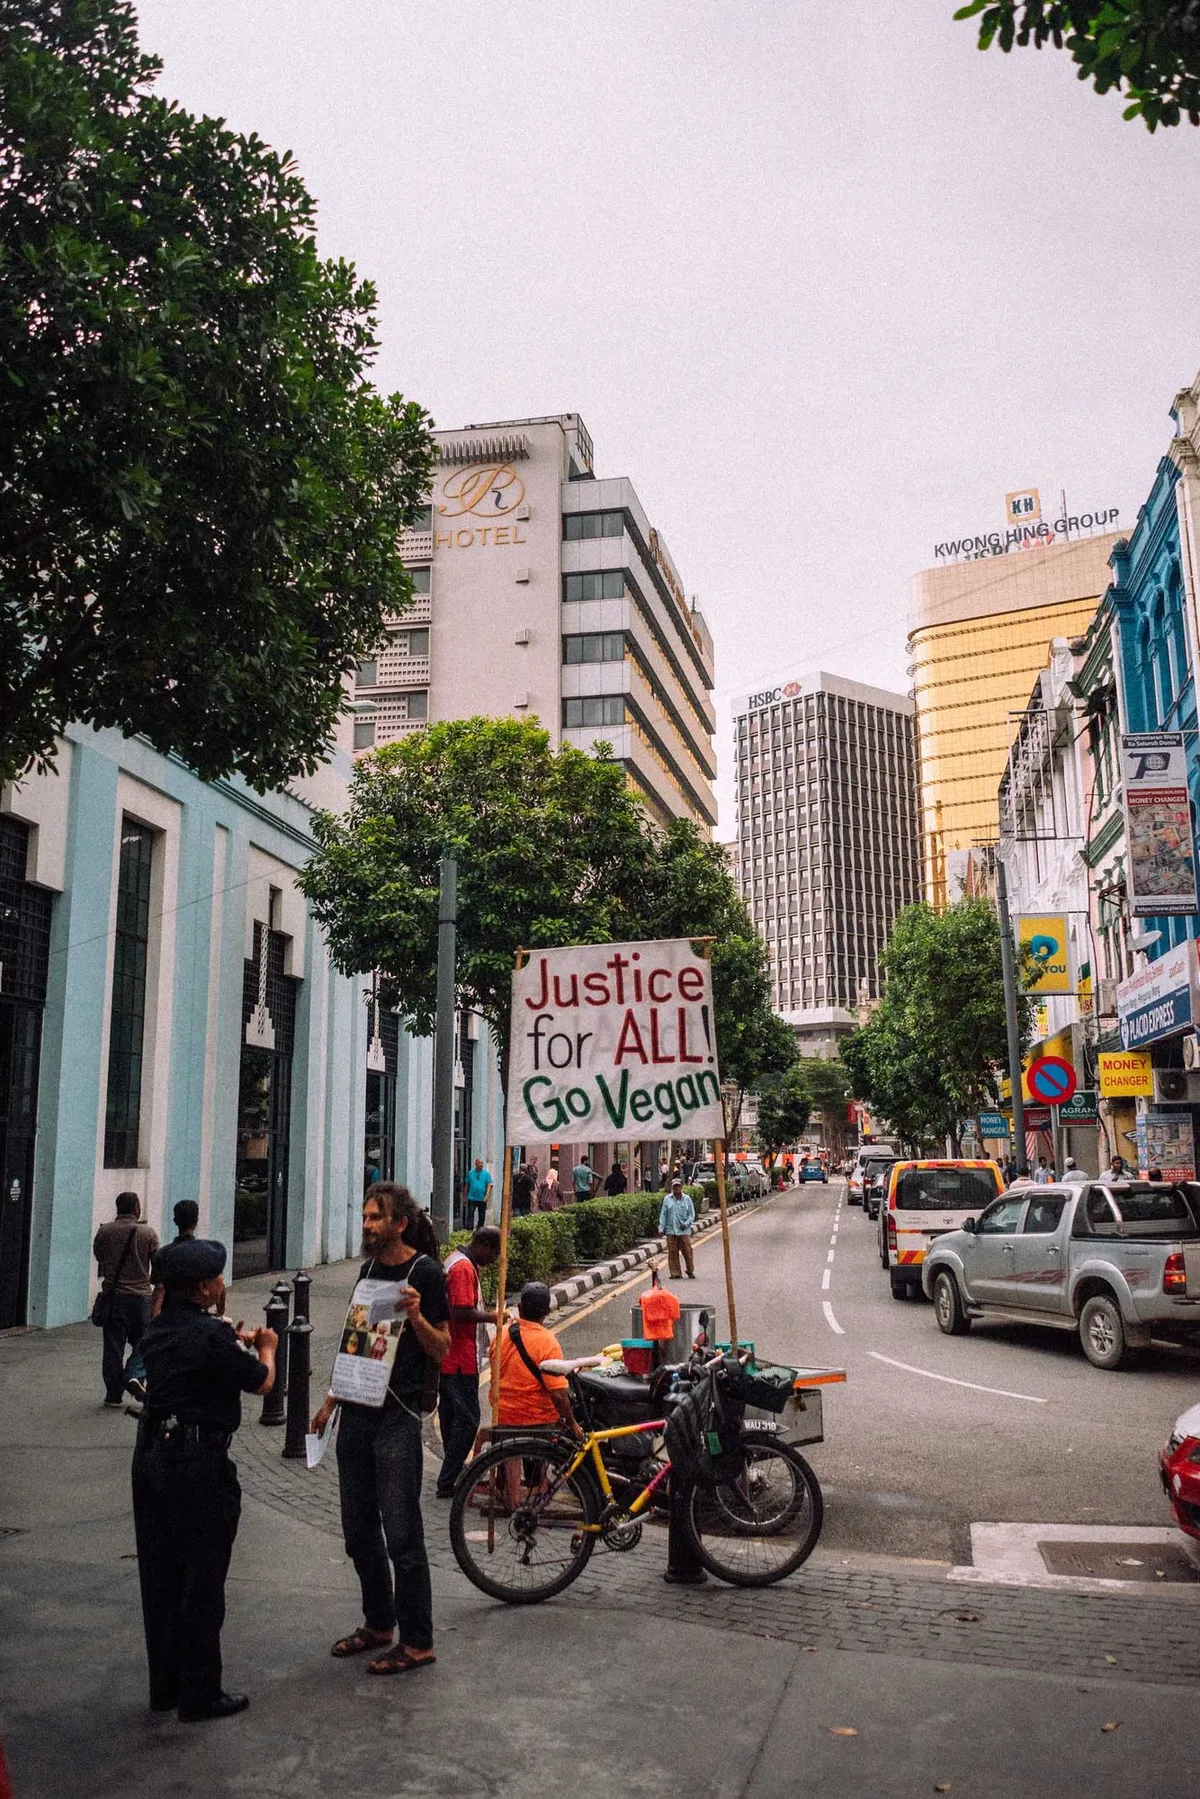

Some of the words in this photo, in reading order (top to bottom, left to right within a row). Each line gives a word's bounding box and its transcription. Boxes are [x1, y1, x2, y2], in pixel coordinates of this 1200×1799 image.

[1011, 497, 1034, 514] KH
[435, 525, 527, 549] HOTEL
[934, 532, 1000, 558] KWONG
[1006, 523, 1049, 544] HING
[1054, 508, 1120, 533] GROUP
[748, 687, 782, 710] HSBC
[1044, 964, 1066, 974] YOU
[525, 952, 704, 1010] Justice
[1129, 1013, 1149, 1042] PLACID
[1148, 1000, 1176, 1034] EXPRESS
[527, 1013, 593, 1070] for
[614, 1005, 714, 1065] ALL!
[1103, 1059, 1147, 1070] MONEY
[1104, 1076, 1149, 1087] CHANGER
[522, 1075, 592, 1132] Go
[595, 1069, 721, 1130] Vegan
[980, 1116, 1001, 1124] MONEY
